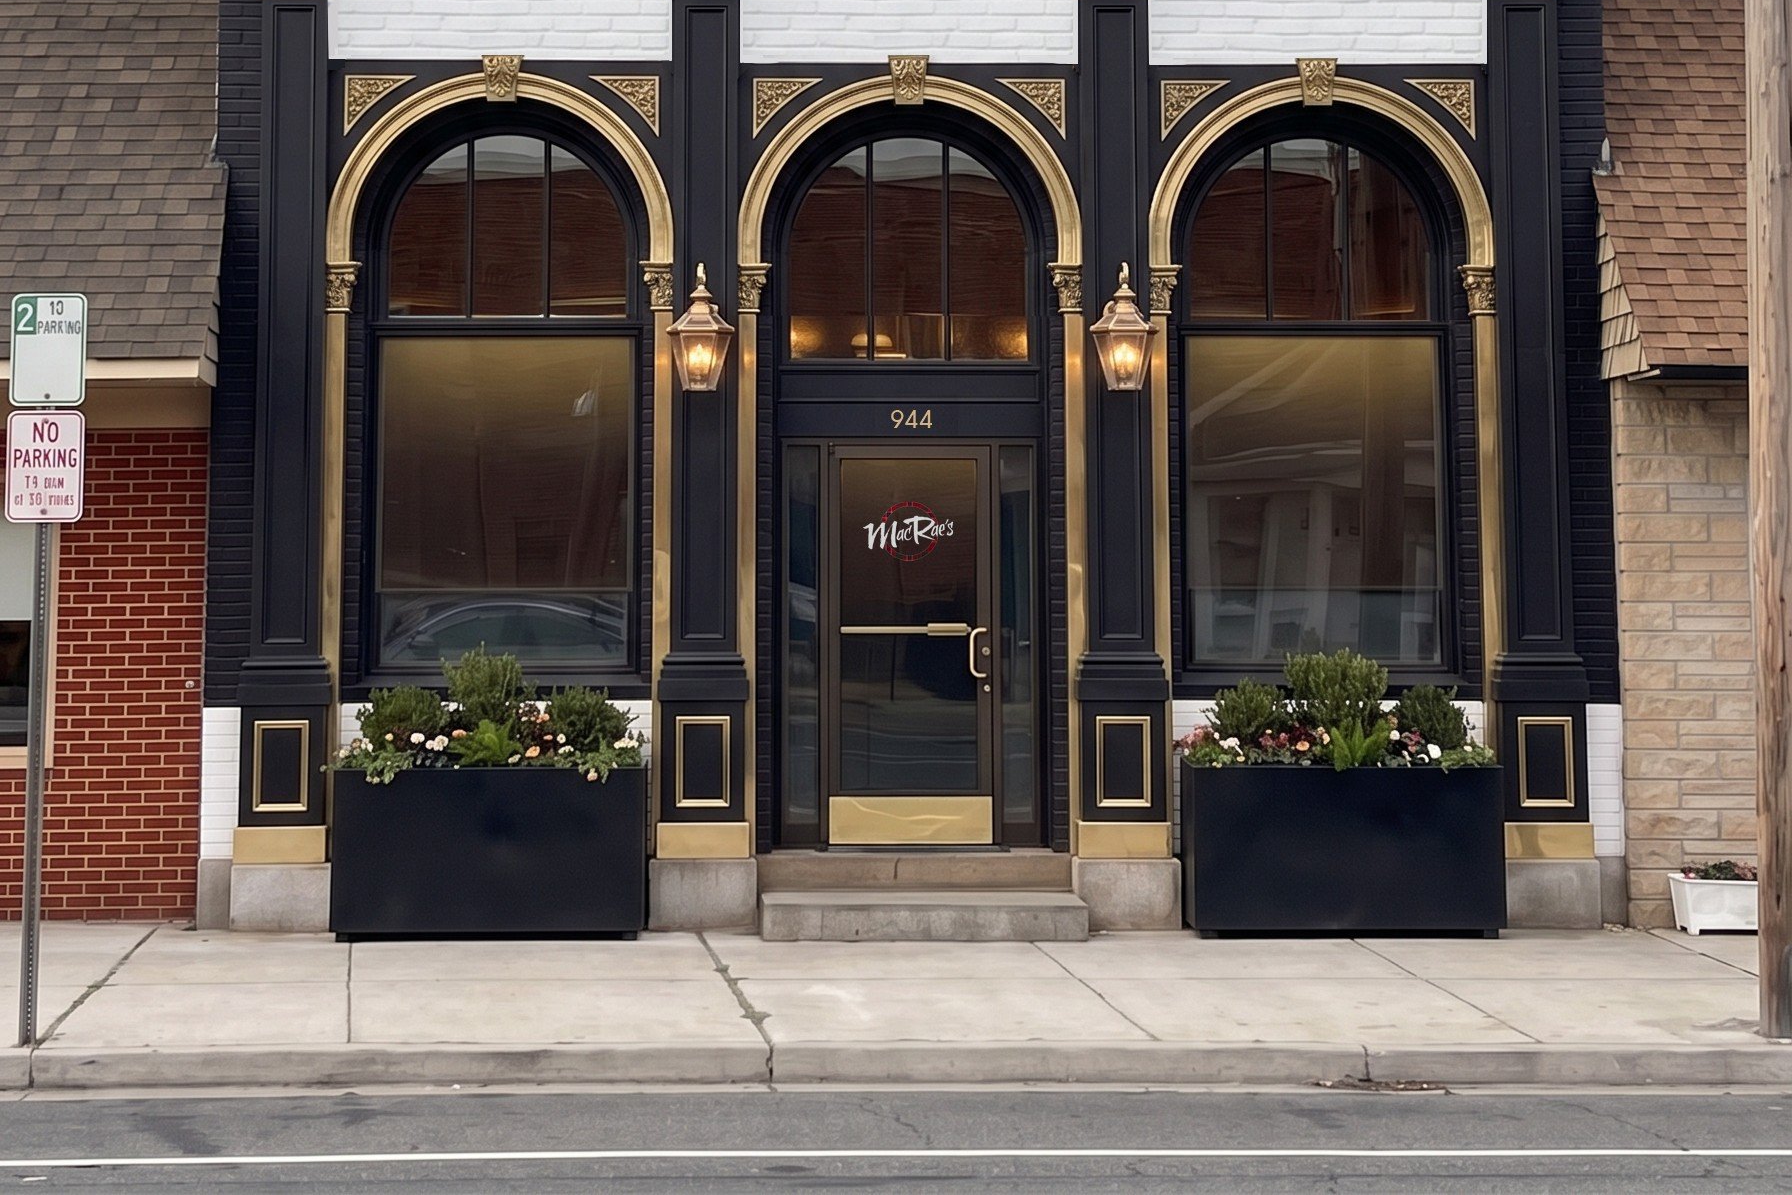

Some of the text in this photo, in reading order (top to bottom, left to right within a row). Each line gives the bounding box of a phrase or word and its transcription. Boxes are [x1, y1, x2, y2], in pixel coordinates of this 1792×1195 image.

[16, 303, 34, 332] 2
[37, 320, 82, 335] PARKING
[890, 409, 933, 429] 944
[33, 422, 59, 443] NO
[13, 448, 77, 469] PARKING
[863, 515, 954, 550] MacRae's
